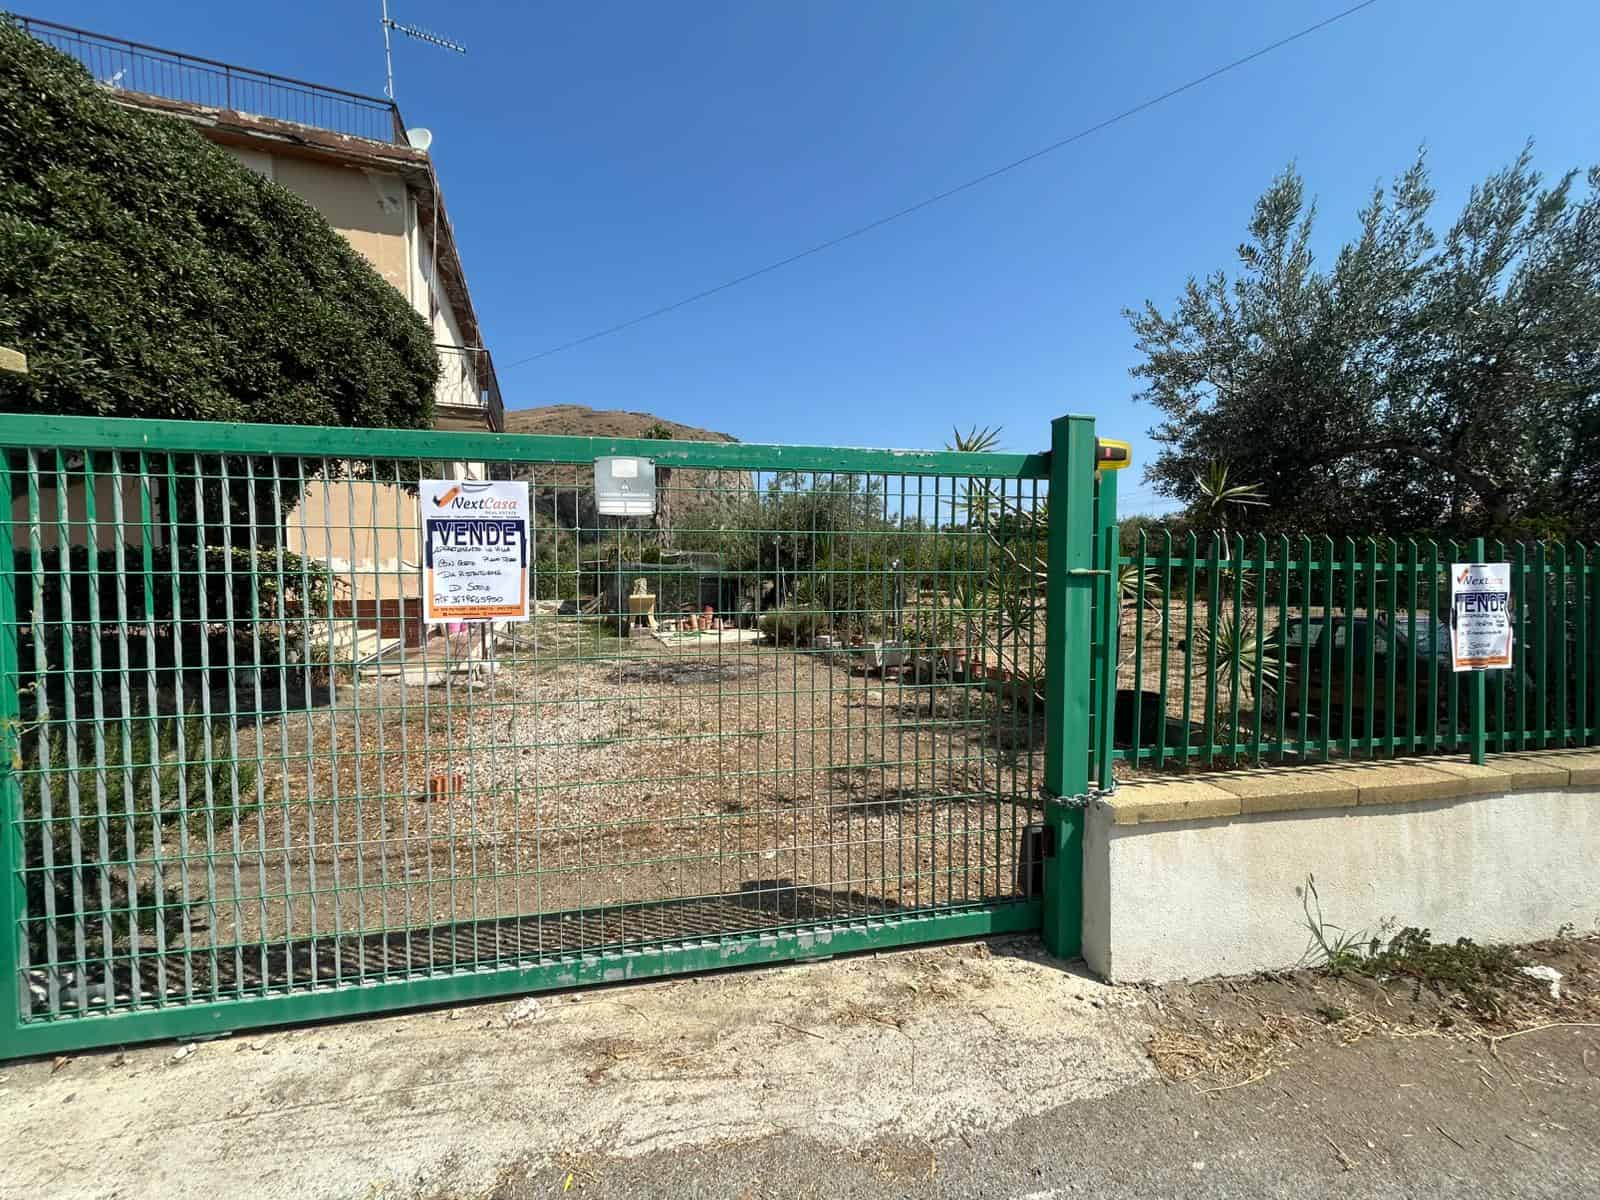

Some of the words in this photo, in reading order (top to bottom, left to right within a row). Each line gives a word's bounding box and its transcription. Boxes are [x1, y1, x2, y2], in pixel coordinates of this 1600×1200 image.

[452, 497, 518, 510] NextCasa
[436, 522, 517, 546] VENDE
[1463, 575, 1504, 585] Next
